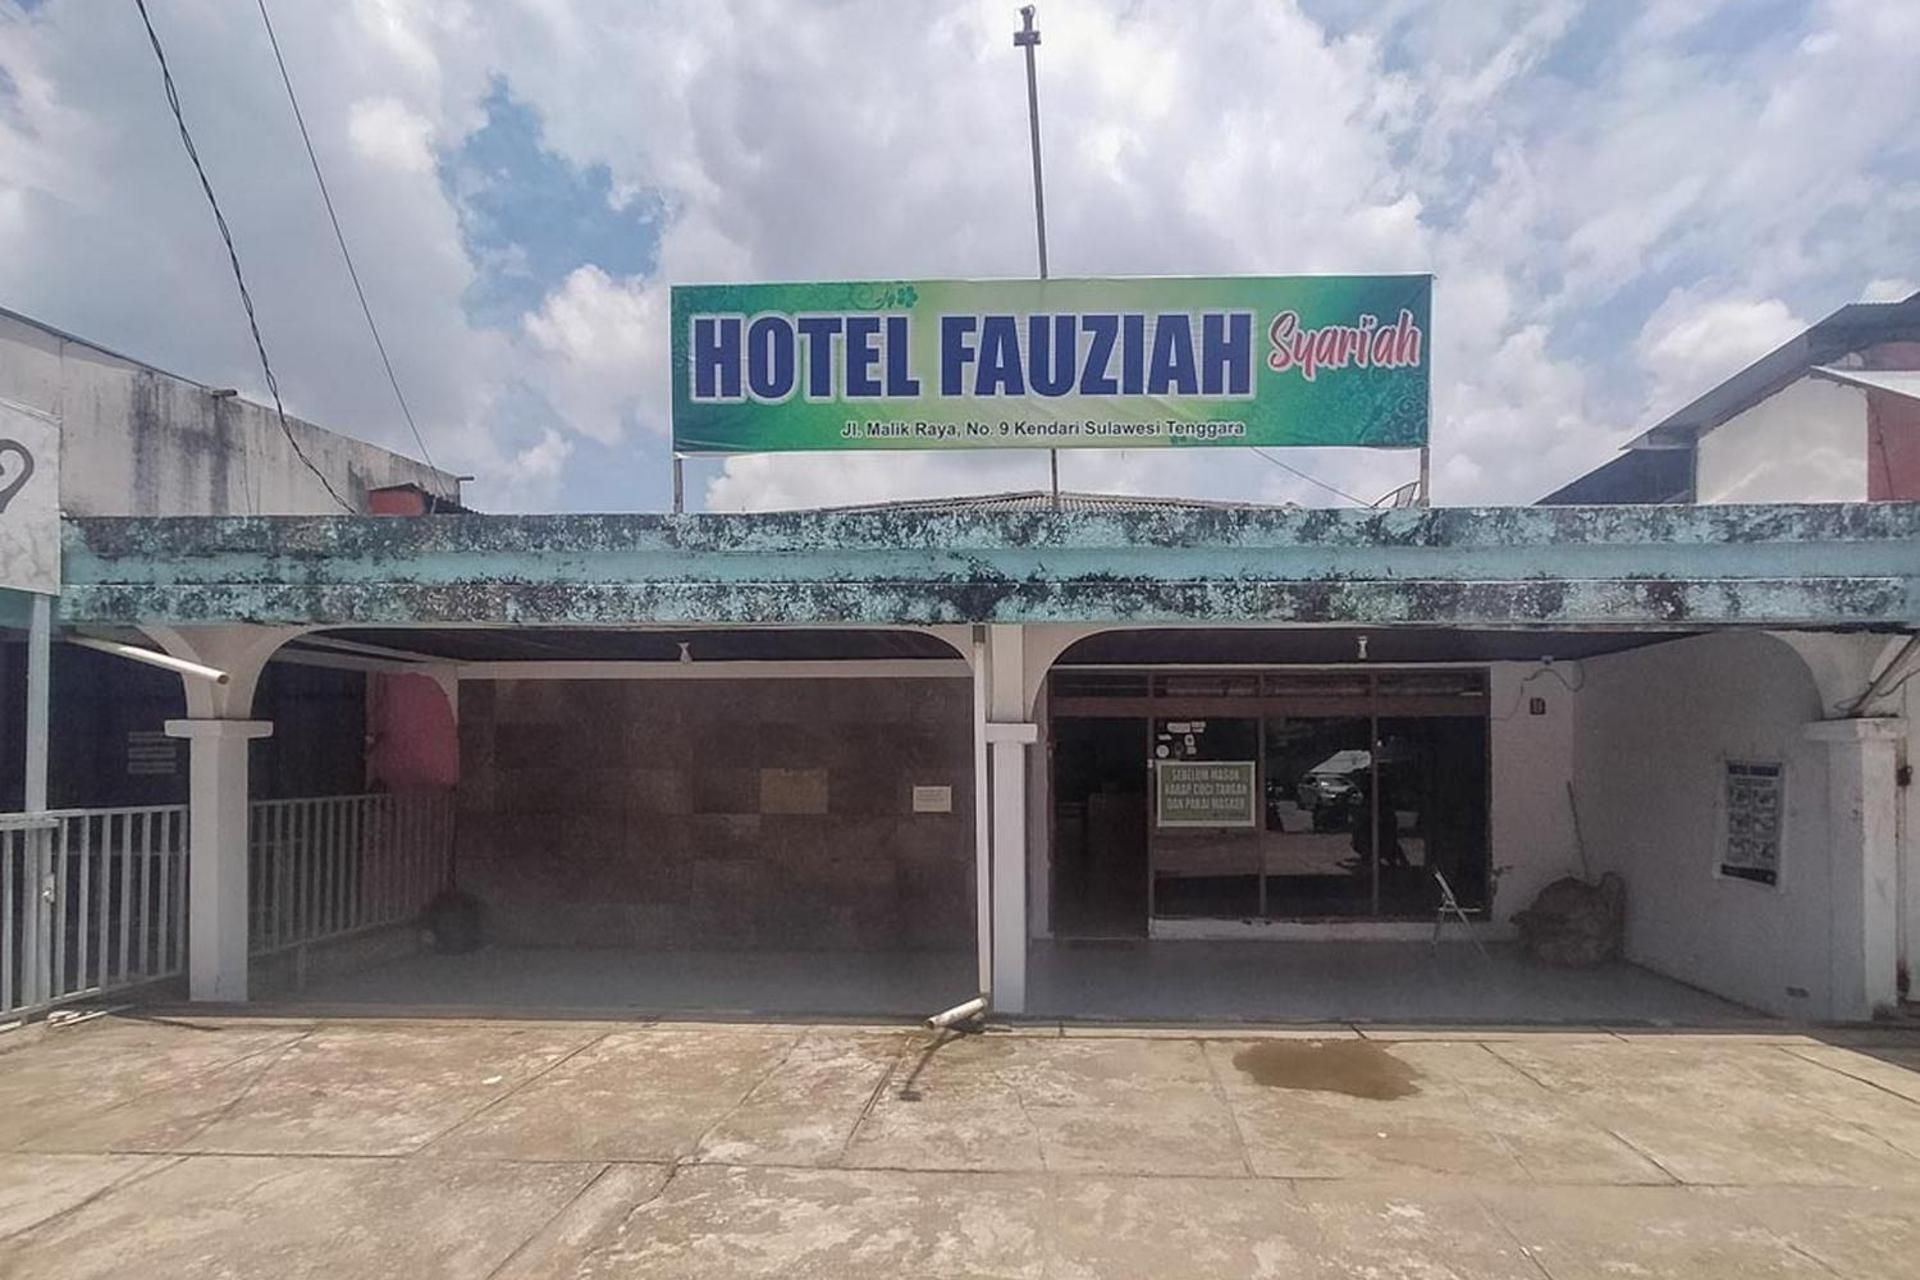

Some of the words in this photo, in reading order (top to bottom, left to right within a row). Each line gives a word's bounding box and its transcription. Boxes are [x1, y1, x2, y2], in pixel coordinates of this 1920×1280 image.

[694, 316, 920, 398] HOTEL
[941, 314, 1250, 396] FAUZIAH
[842, 422, 861, 438] Jl.
[867, 422, 909, 437] Malik
[915, 422, 961, 438] Raya,
[966, 421, 994, 436] No.
[1000, 421, 1010, 436] 9
[1014, 420, 1080, 436] Kendari
[1085, 420, 1161, 436] Sulawesi
[1166, 420, 1245, 439] Tenggara
